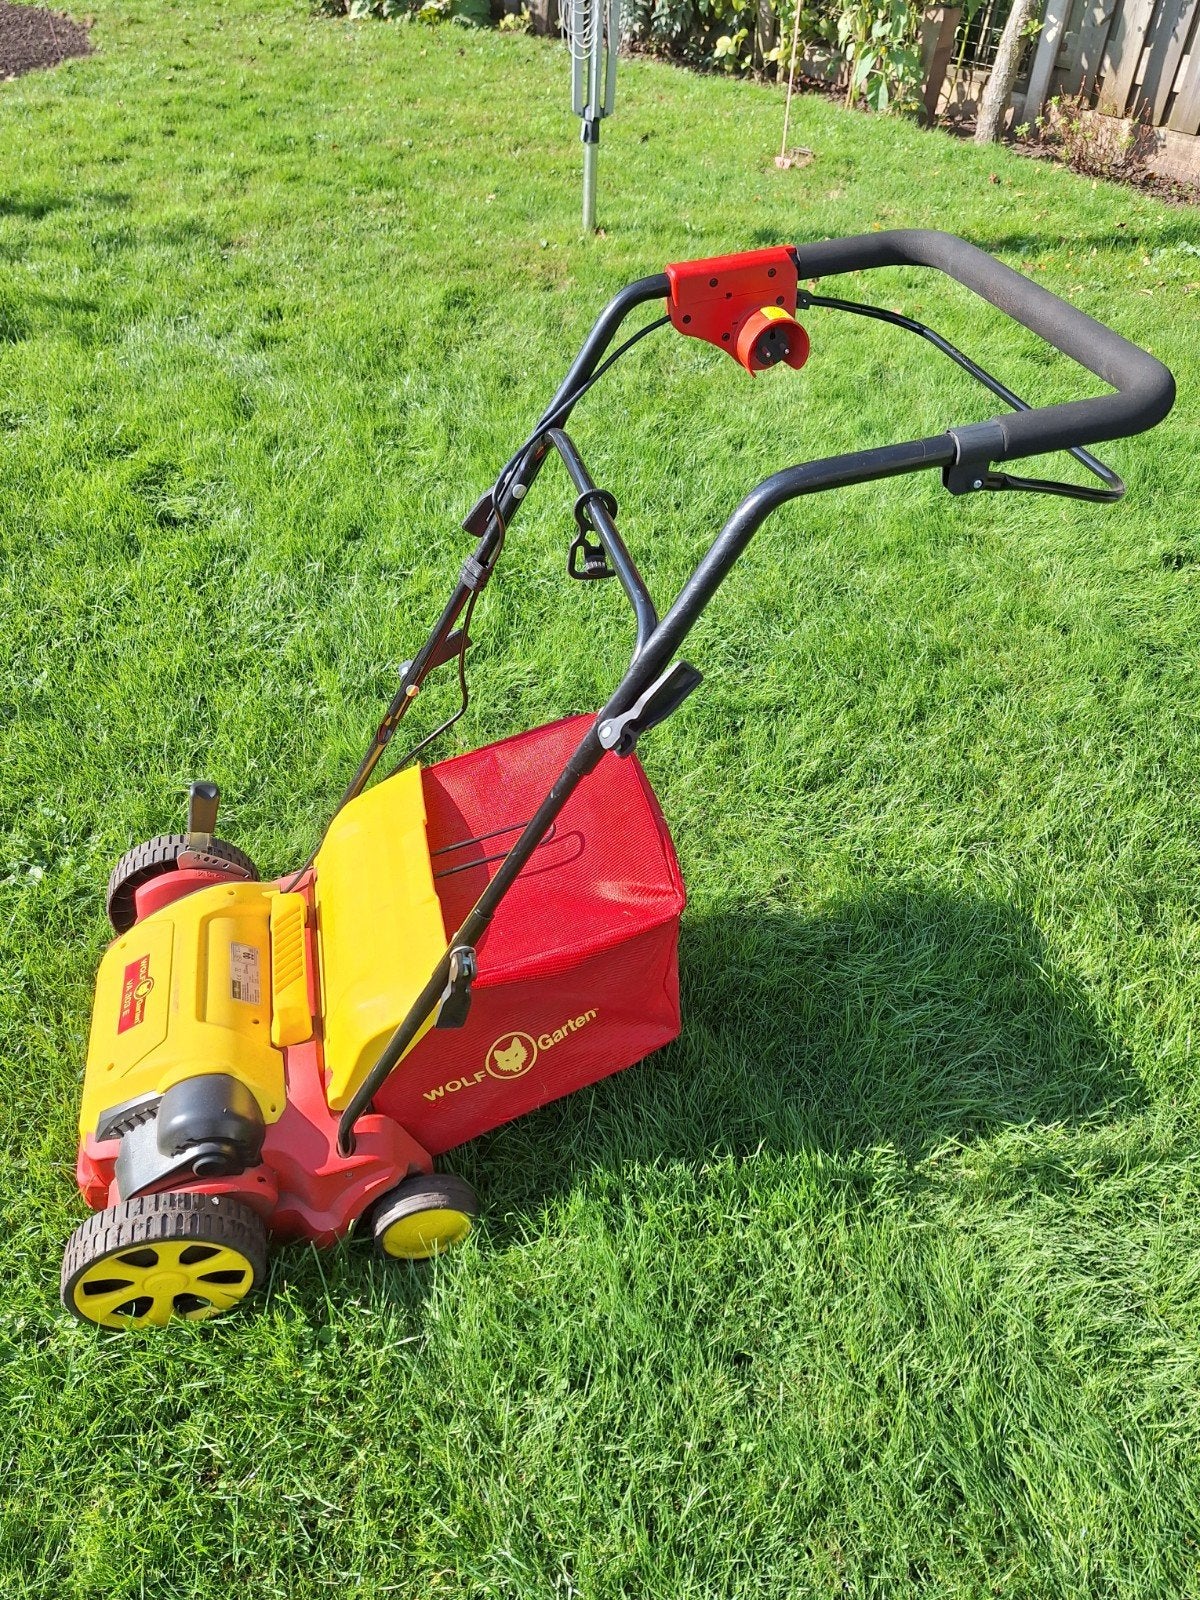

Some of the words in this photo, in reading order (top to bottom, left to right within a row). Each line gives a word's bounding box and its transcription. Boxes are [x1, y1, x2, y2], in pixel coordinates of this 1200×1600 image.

[140, 958, 148, 981] WOLF
[422, 1070, 487, 1101] WOLF
[537, 1009, 597, 1051] Garten
